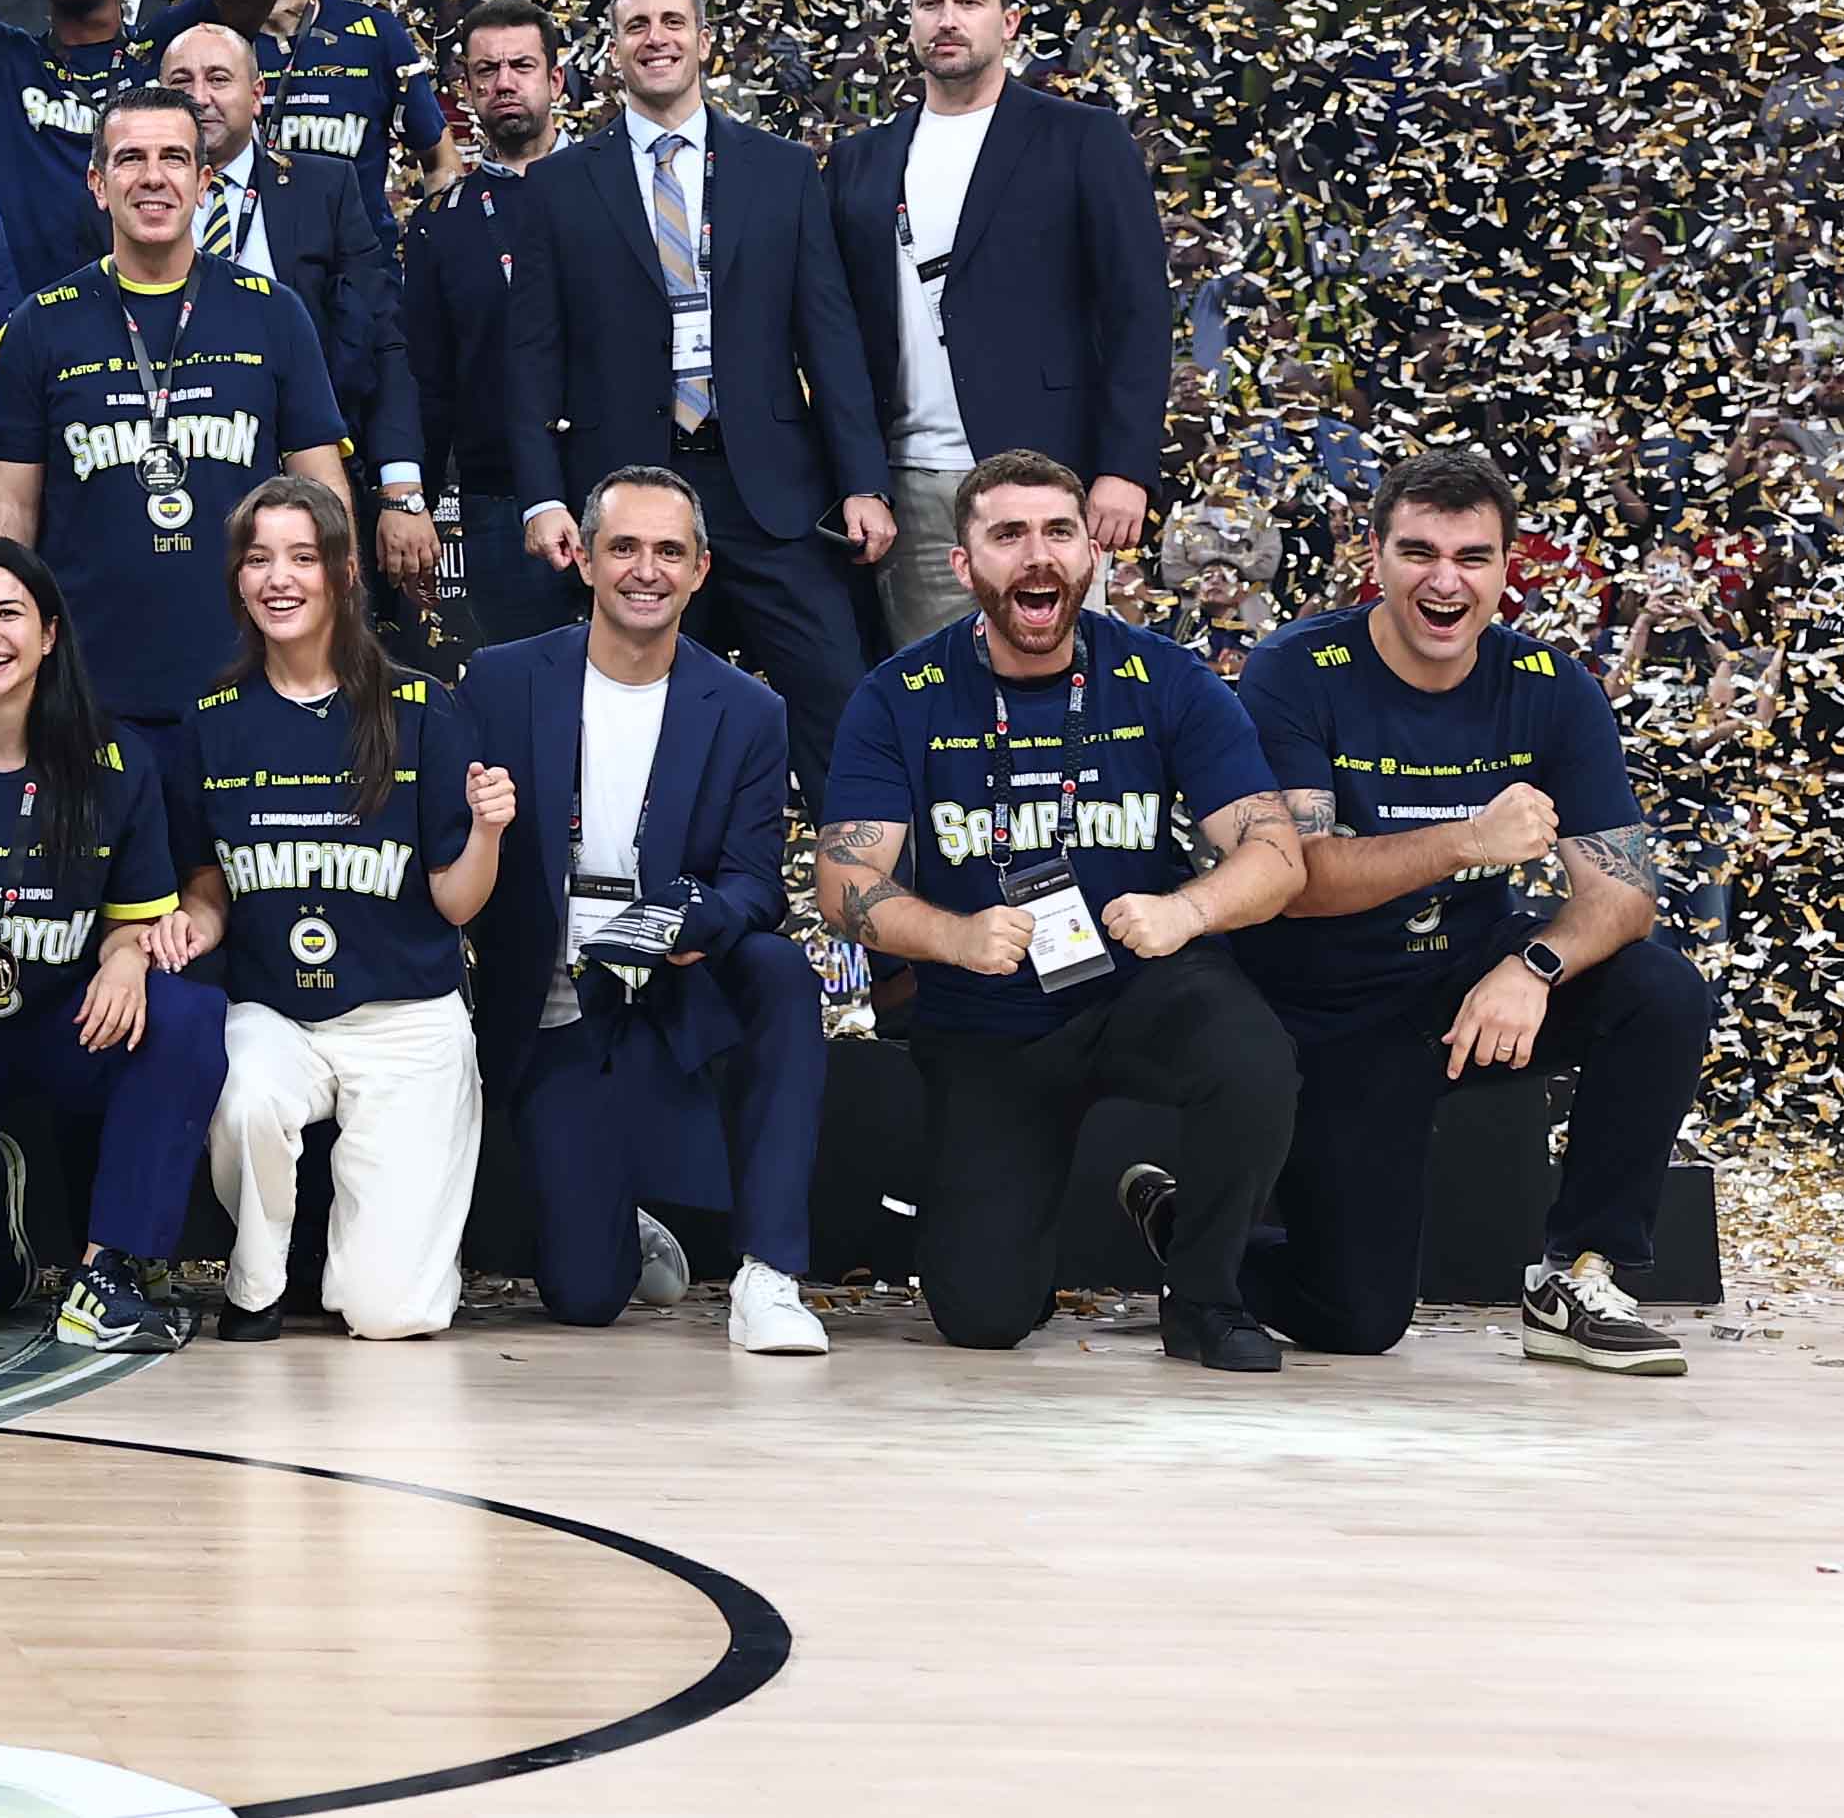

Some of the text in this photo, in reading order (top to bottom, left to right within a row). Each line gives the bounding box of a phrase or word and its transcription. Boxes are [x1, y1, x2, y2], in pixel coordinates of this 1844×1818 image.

[278, 112, 369, 158] PİYON
[37, 286, 78, 306] tarfin
[70, 352, 231, 377] ASTOR BİLFEN
[187, 387, 213, 399] KUPASI
[153, 533, 192, 552] tarfin
[1312, 644, 1352, 668] arfin
[902, 663, 944, 691] tarfin
[198, 687, 238, 710] tarfin
[946, 738, 979, 749] ASTOR
[1034, 736, 1062, 747] Hotels
[1401, 764, 1431, 776] Limak
[1433, 765, 1461, 776] Hotels
[216, 778, 247, 788] ASTOR
[271, 774, 300, 785] Limak
[302, 774, 330, 785] Hotels
[930, 792, 1160, 866] ŞAMPYON
[215, 839, 412, 901] ŞAMPİYON
[25, 887, 53, 901] KUPASI
[296, 968, 334, 989] tarfin
